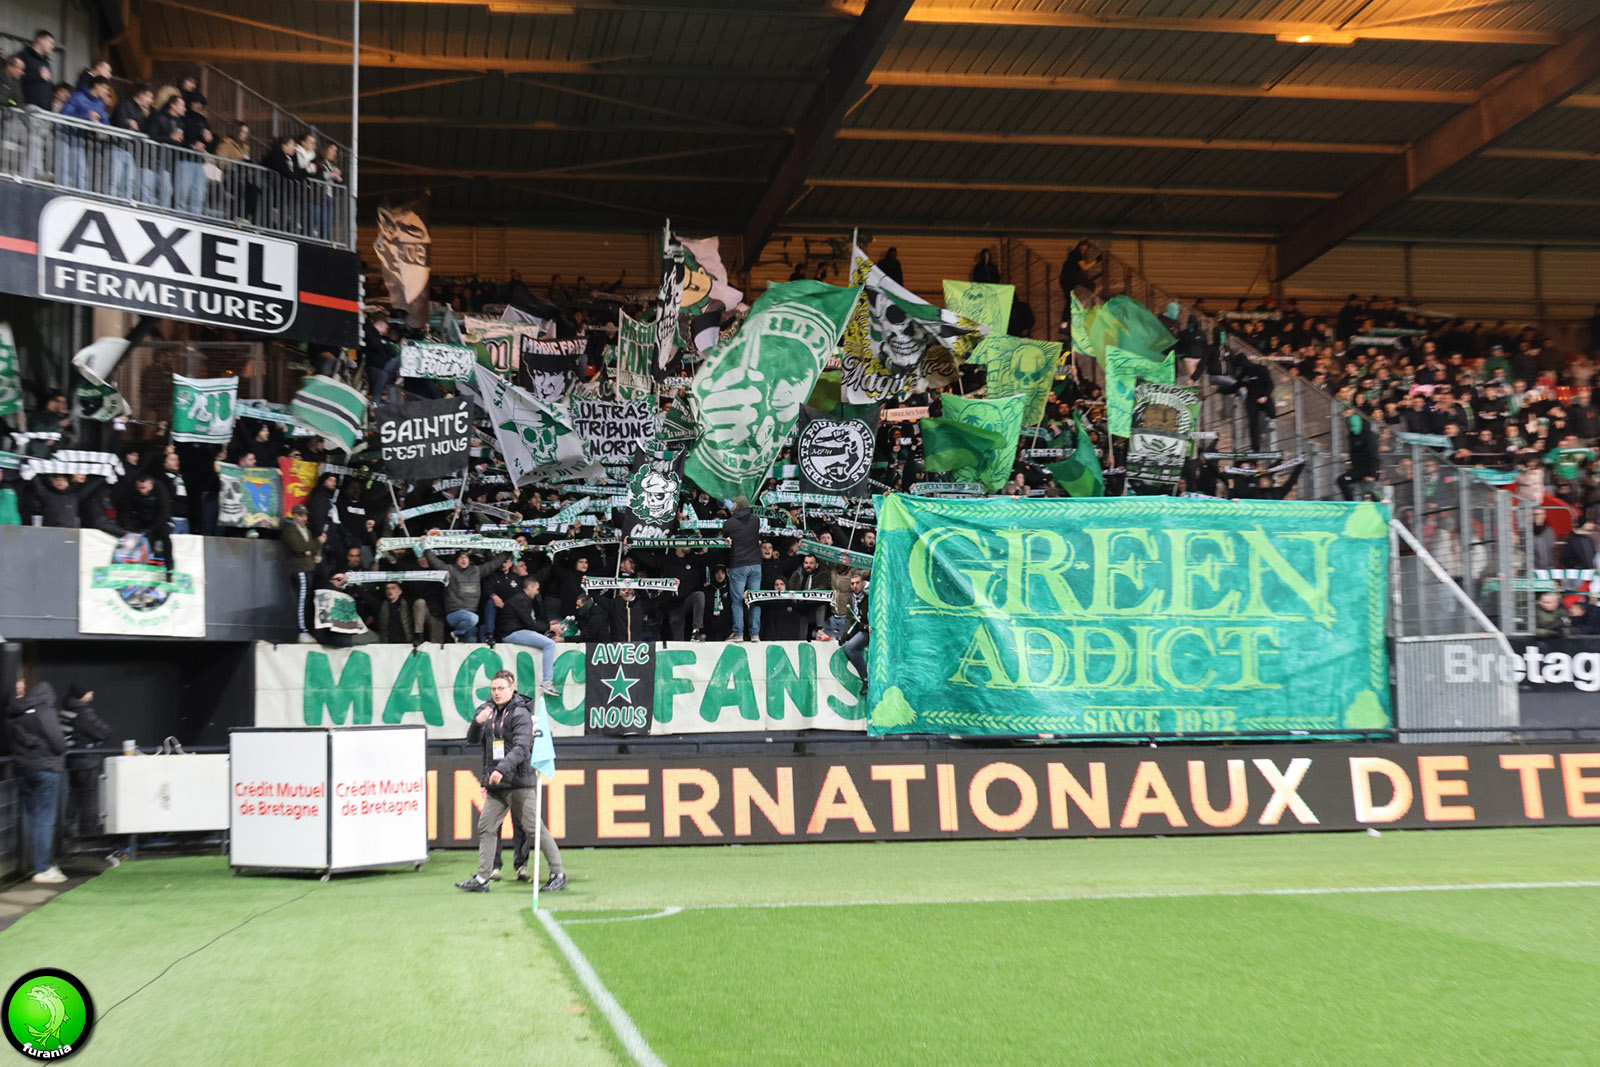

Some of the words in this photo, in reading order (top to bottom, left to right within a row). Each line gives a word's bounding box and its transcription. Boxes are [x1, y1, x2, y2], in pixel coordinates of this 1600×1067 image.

[59, 209, 283, 292] AXEL
[54, 265, 284, 326] FERMETURES
[380, 401, 469, 444] SAINTÉ
[580, 402, 649, 421] ULTRAS
[382, 445, 427, 462] C'EST
[430, 437, 468, 456] NOUS
[590, 439, 638, 457] NORD
[801, 438, 833, 488] LIBERTE
[851, 429, 874, 482] ULTRAS
[637, 538, 680, 548] MAGIC
[908, 524, 1338, 628] GREEN
[802, 591, 834, 600] Gard
[592, 642, 650, 666] AVEC
[948, 622, 1285, 692] ADDICT
[303, 646, 586, 727] MAGIC
[653, 644, 866, 724] FANS
[589, 705, 647, 730] NOUS
[1083, 708, 1160, 733] SINCE
[1174, 708, 1238, 733] 1992
[234, 781, 275, 798] Crédit
[276, 782, 325, 799] Mutuel
[336, 779, 377, 797] Crédit
[378, 777, 424, 796] Mutuel
[1349, 756, 1475, 823] DE
[240, 800, 256, 816] de
[258, 801, 319, 820] Bretagne
[341, 800, 357, 816] de
[360, 798, 419, 817] Bretagne
